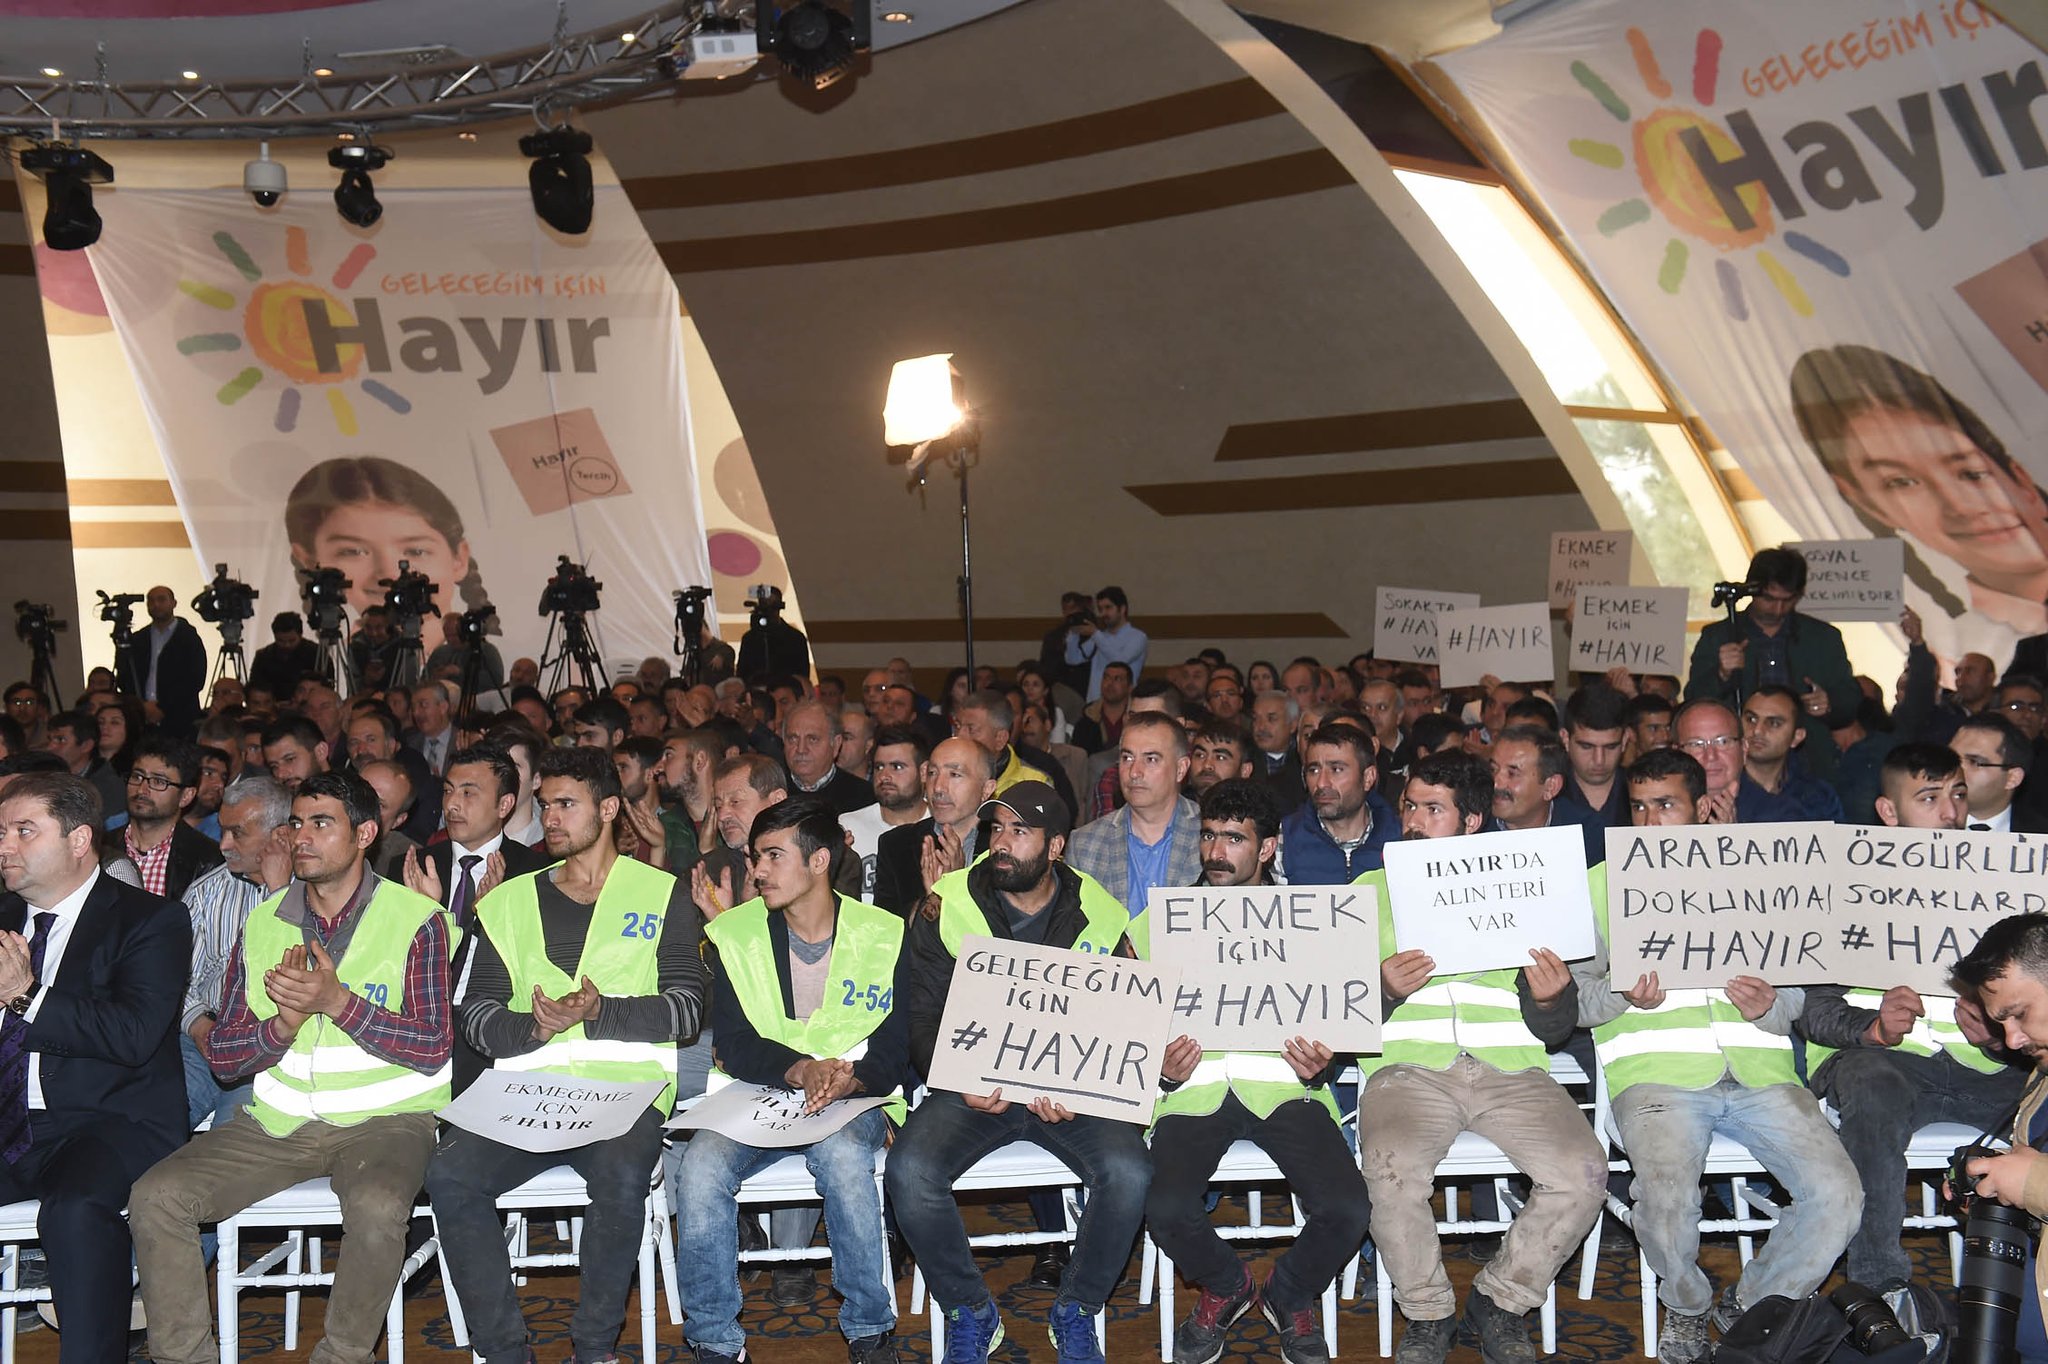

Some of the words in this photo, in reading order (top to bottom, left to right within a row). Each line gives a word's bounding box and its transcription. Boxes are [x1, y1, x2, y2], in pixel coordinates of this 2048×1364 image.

[1741, 9, 1934, 98] GELECEĞİM
[1677, 60, 2048, 232] Hayır
[301, 296, 611, 396] Hayır
[532, 445, 579, 470] Hayır
[577, 470, 612, 482] Tercih
[1558, 537, 1618, 556] EKMEK
[1803, 549, 1862, 564] OSYAL
[1583, 596, 1660, 616] EKMEK
[1412, 645, 1437, 659] VA
[1621, 833, 1827, 872] ARABAMA
[1433, 885, 1487, 907] ALIN
[1492, 876, 1546, 901] TERİ
[1843, 883, 2048, 914] SOKAKLARD
[1165, 893, 1367, 934] EKMEK
[1467, 912, 1518, 932] VAR
[965, 950, 1163, 1005] GELECEĞİM
[842, 978, 893, 1014] 2-54
[504, 1082, 633, 1103] EKMEĞİMİZ
[534, 1098, 583, 1116] İÇİN
[753, 1110, 792, 1131] VAR
